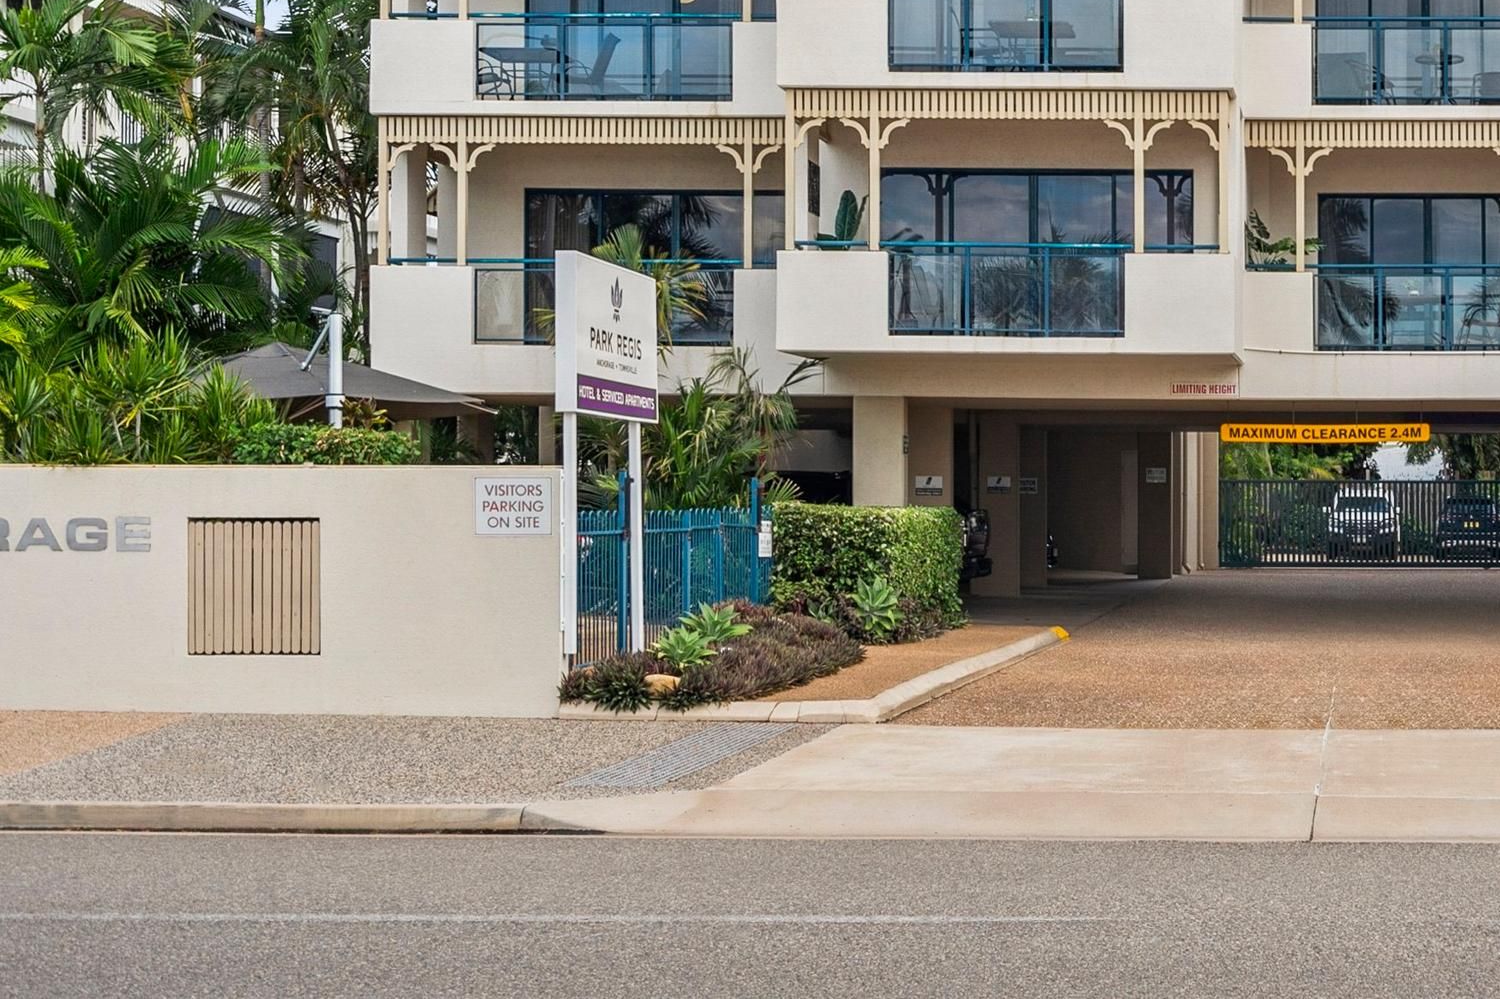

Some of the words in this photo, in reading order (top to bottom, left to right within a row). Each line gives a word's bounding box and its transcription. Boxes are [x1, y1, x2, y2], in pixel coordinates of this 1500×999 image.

[590, 326, 613, 353] PARK
[616, 333, 642, 360] REGIS
[1172, 383, 1207, 394] LIMITING
[1208, 383, 1237, 394] HEIGHT
[578, 385, 596, 400] HOTEL
[601, 389, 625, 405] SERVICED
[625, 393, 655, 411] APARTMENTS
[1229, 427, 1297, 439] MAXIMUM
[1301, 427, 1386, 440] CLEARANCE
[1390, 426, 1422, 438] 2.4M
[484, 484, 543, 497] VISITORS
[482, 500, 545, 513] PARKING
[487, 516, 510, 529] ON
[514, 516, 540, 529] SITE
[0, 516, 152, 552] AGE
